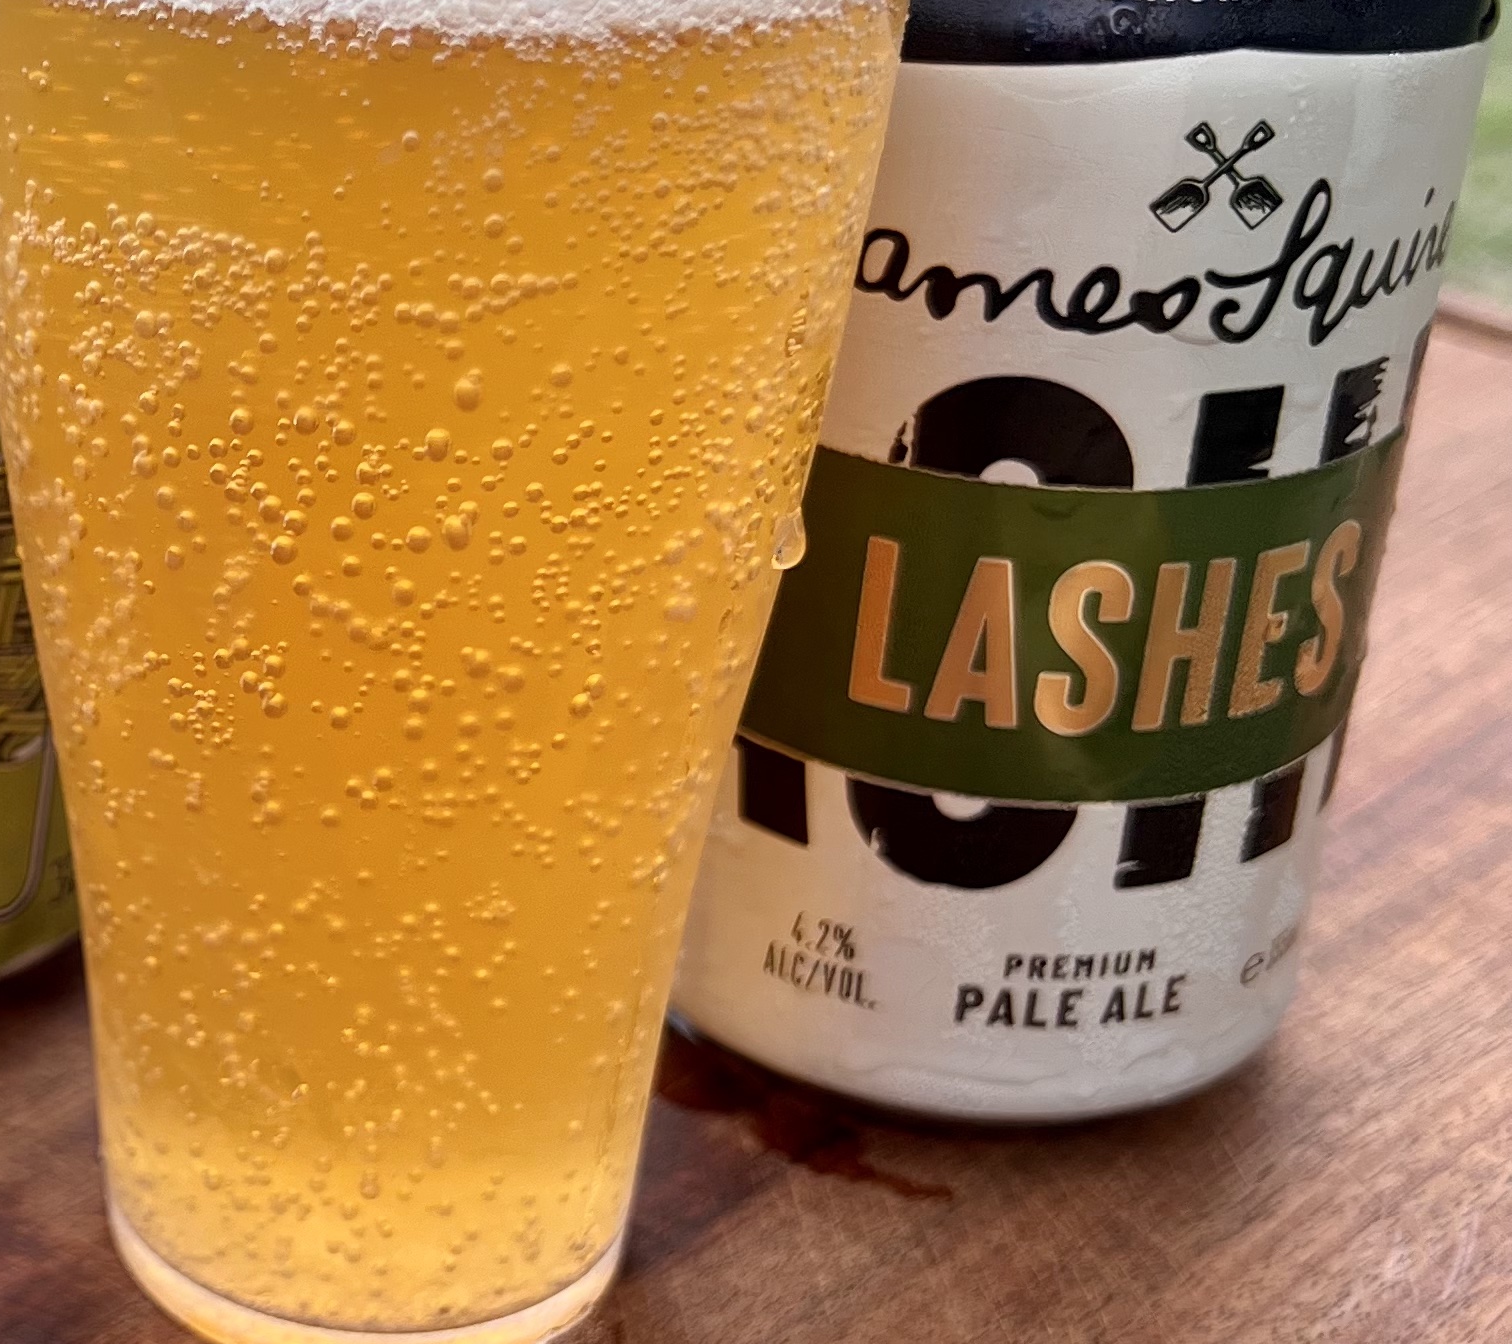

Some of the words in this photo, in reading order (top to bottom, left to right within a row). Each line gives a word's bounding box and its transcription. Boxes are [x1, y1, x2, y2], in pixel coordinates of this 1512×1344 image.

[854, 226, 1200, 335] ames
[847, 518, 1362, 738] LASHES
[790, 910, 856, 961] 4.2%
[1002, 947, 1158, 981] PREMIUM
[953, 983, 1084, 1029] PALE
[1099, 973, 1187, 1025] ALE
